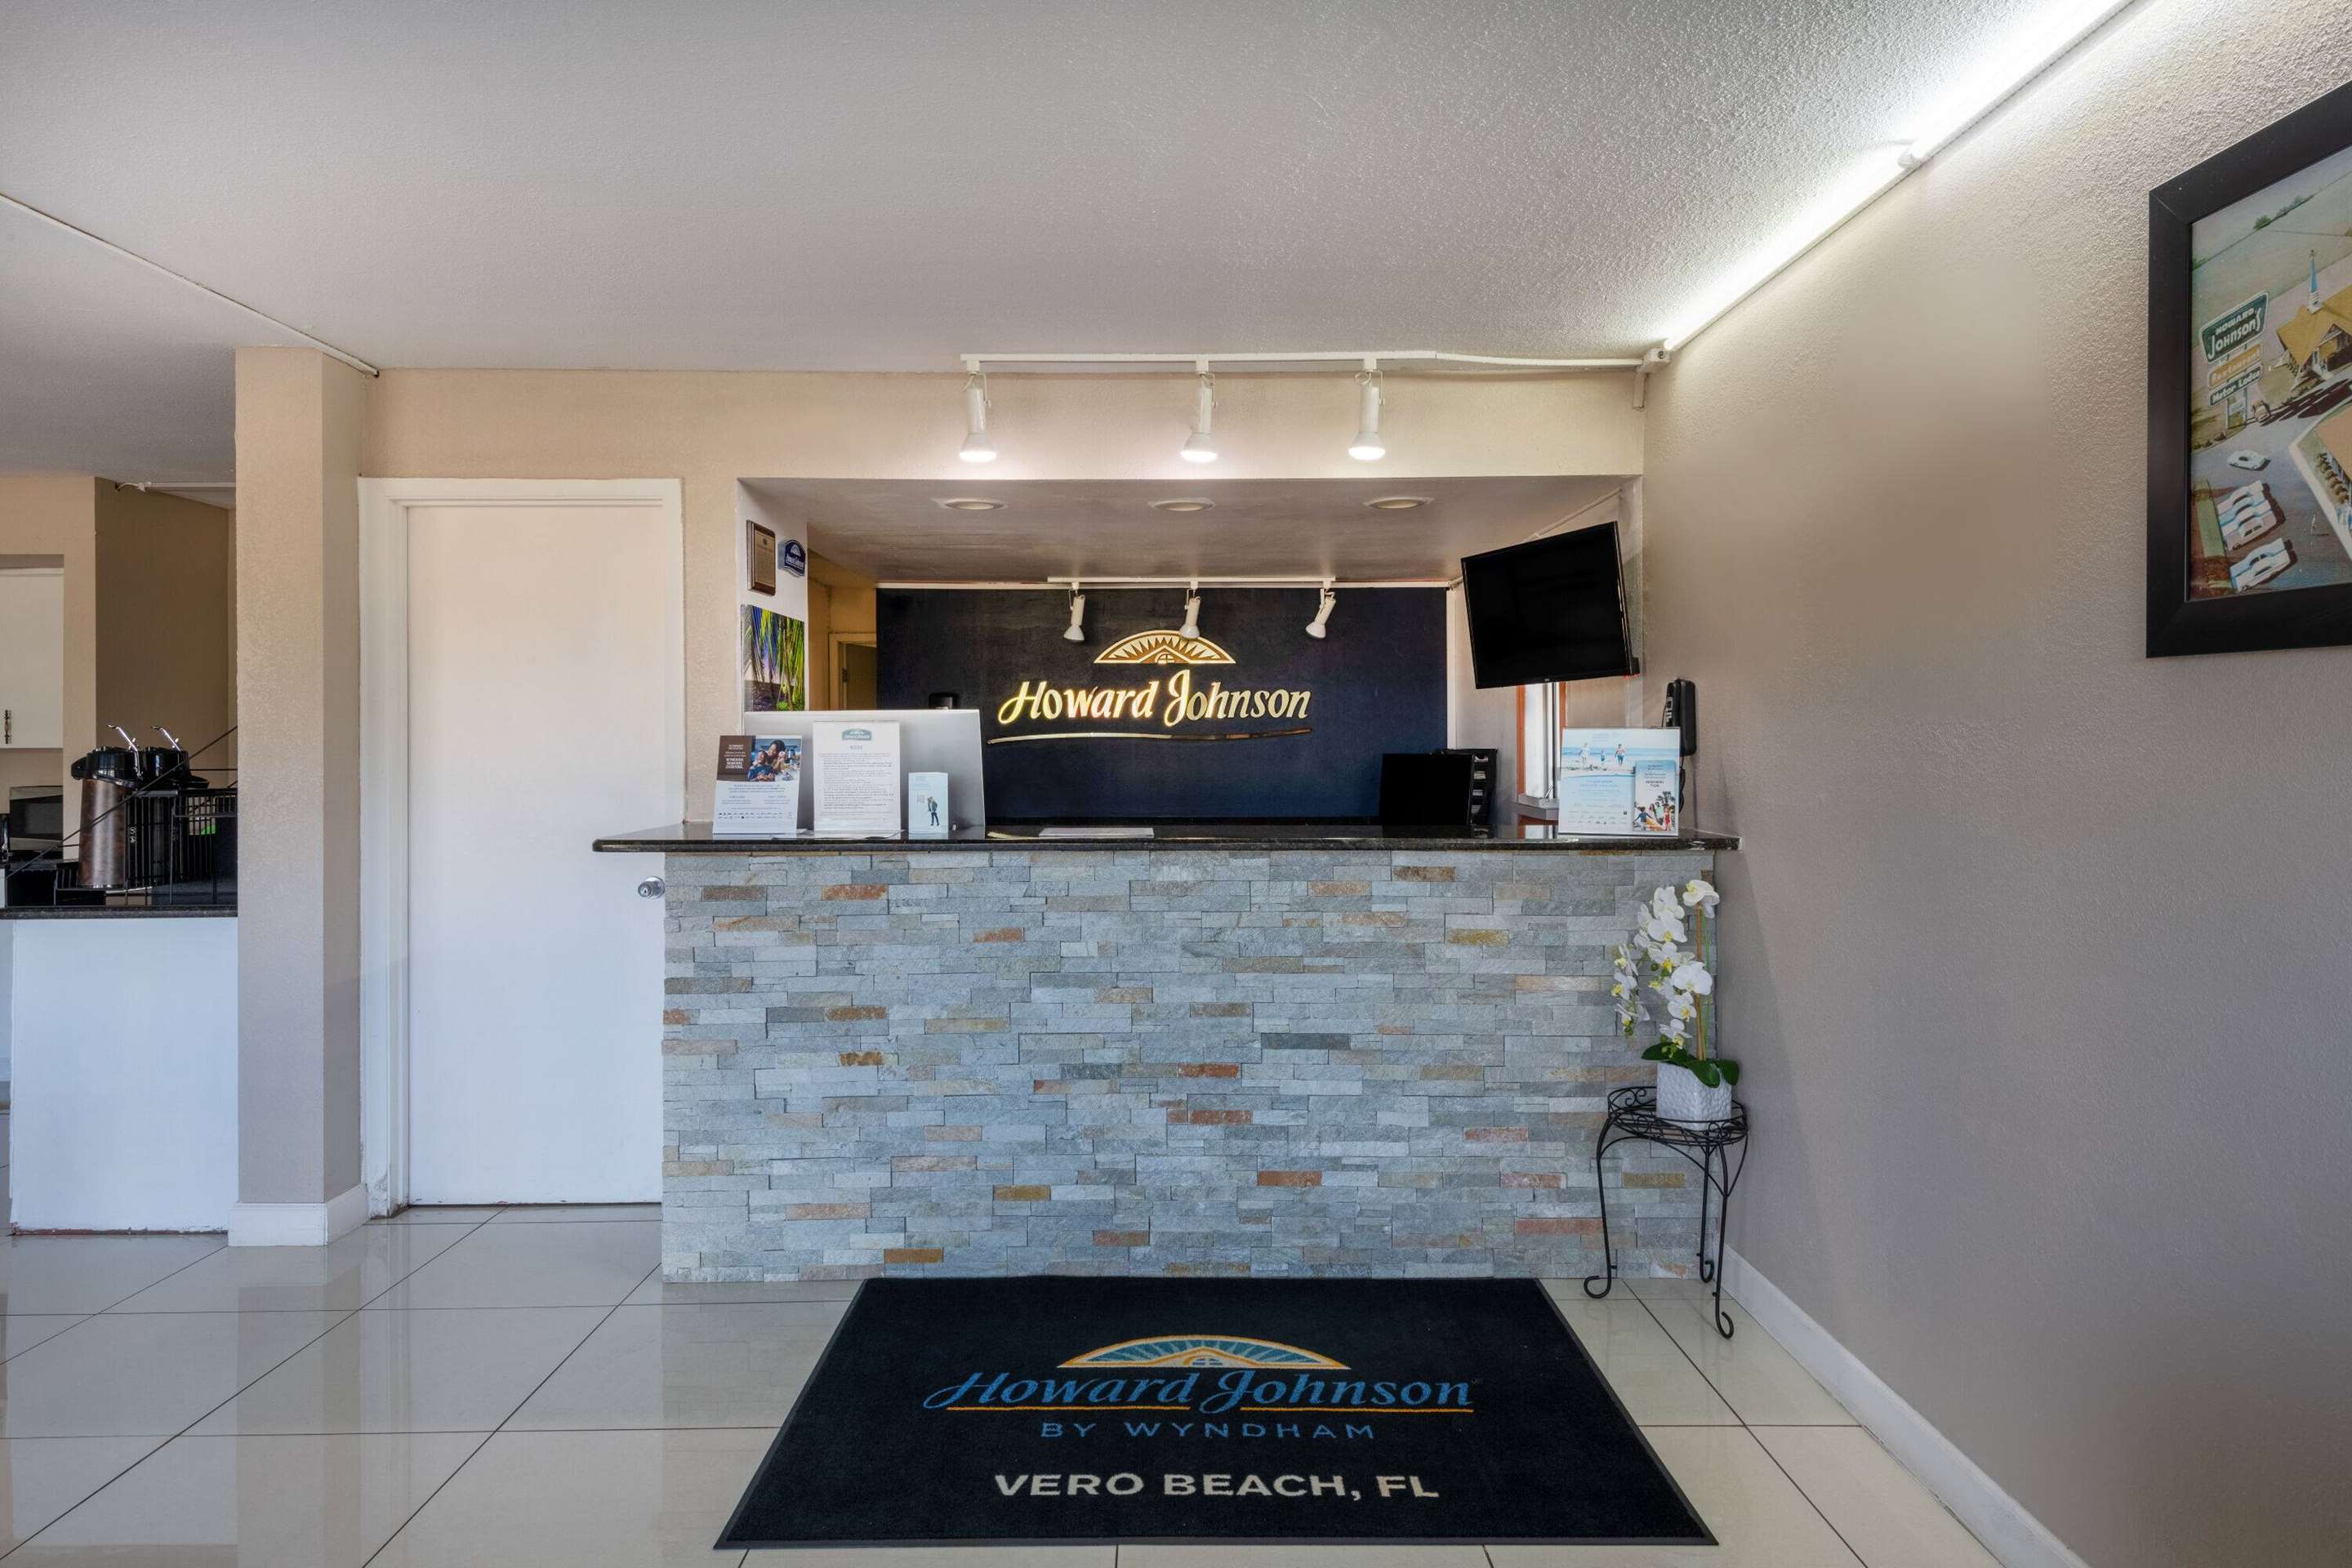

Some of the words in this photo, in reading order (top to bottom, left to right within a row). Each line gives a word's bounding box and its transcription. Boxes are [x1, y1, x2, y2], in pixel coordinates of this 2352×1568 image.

[2216, 308, 2255, 336] HOWARD
[998, 680, 1160, 725] Howard
[1163, 669, 1312, 728] Johnson
[922, 1371, 1198, 1409] Howard
[1199, 1370, 1473, 1414] Johnson
[1040, 1422, 1097, 1438] BY
[1125, 1422, 1374, 1440] WYNDHAM
[994, 1472, 1144, 1497] VERO
[1163, 1472, 1361, 1501] BEACH,
[1375, 1474, 1440, 1498] FL
